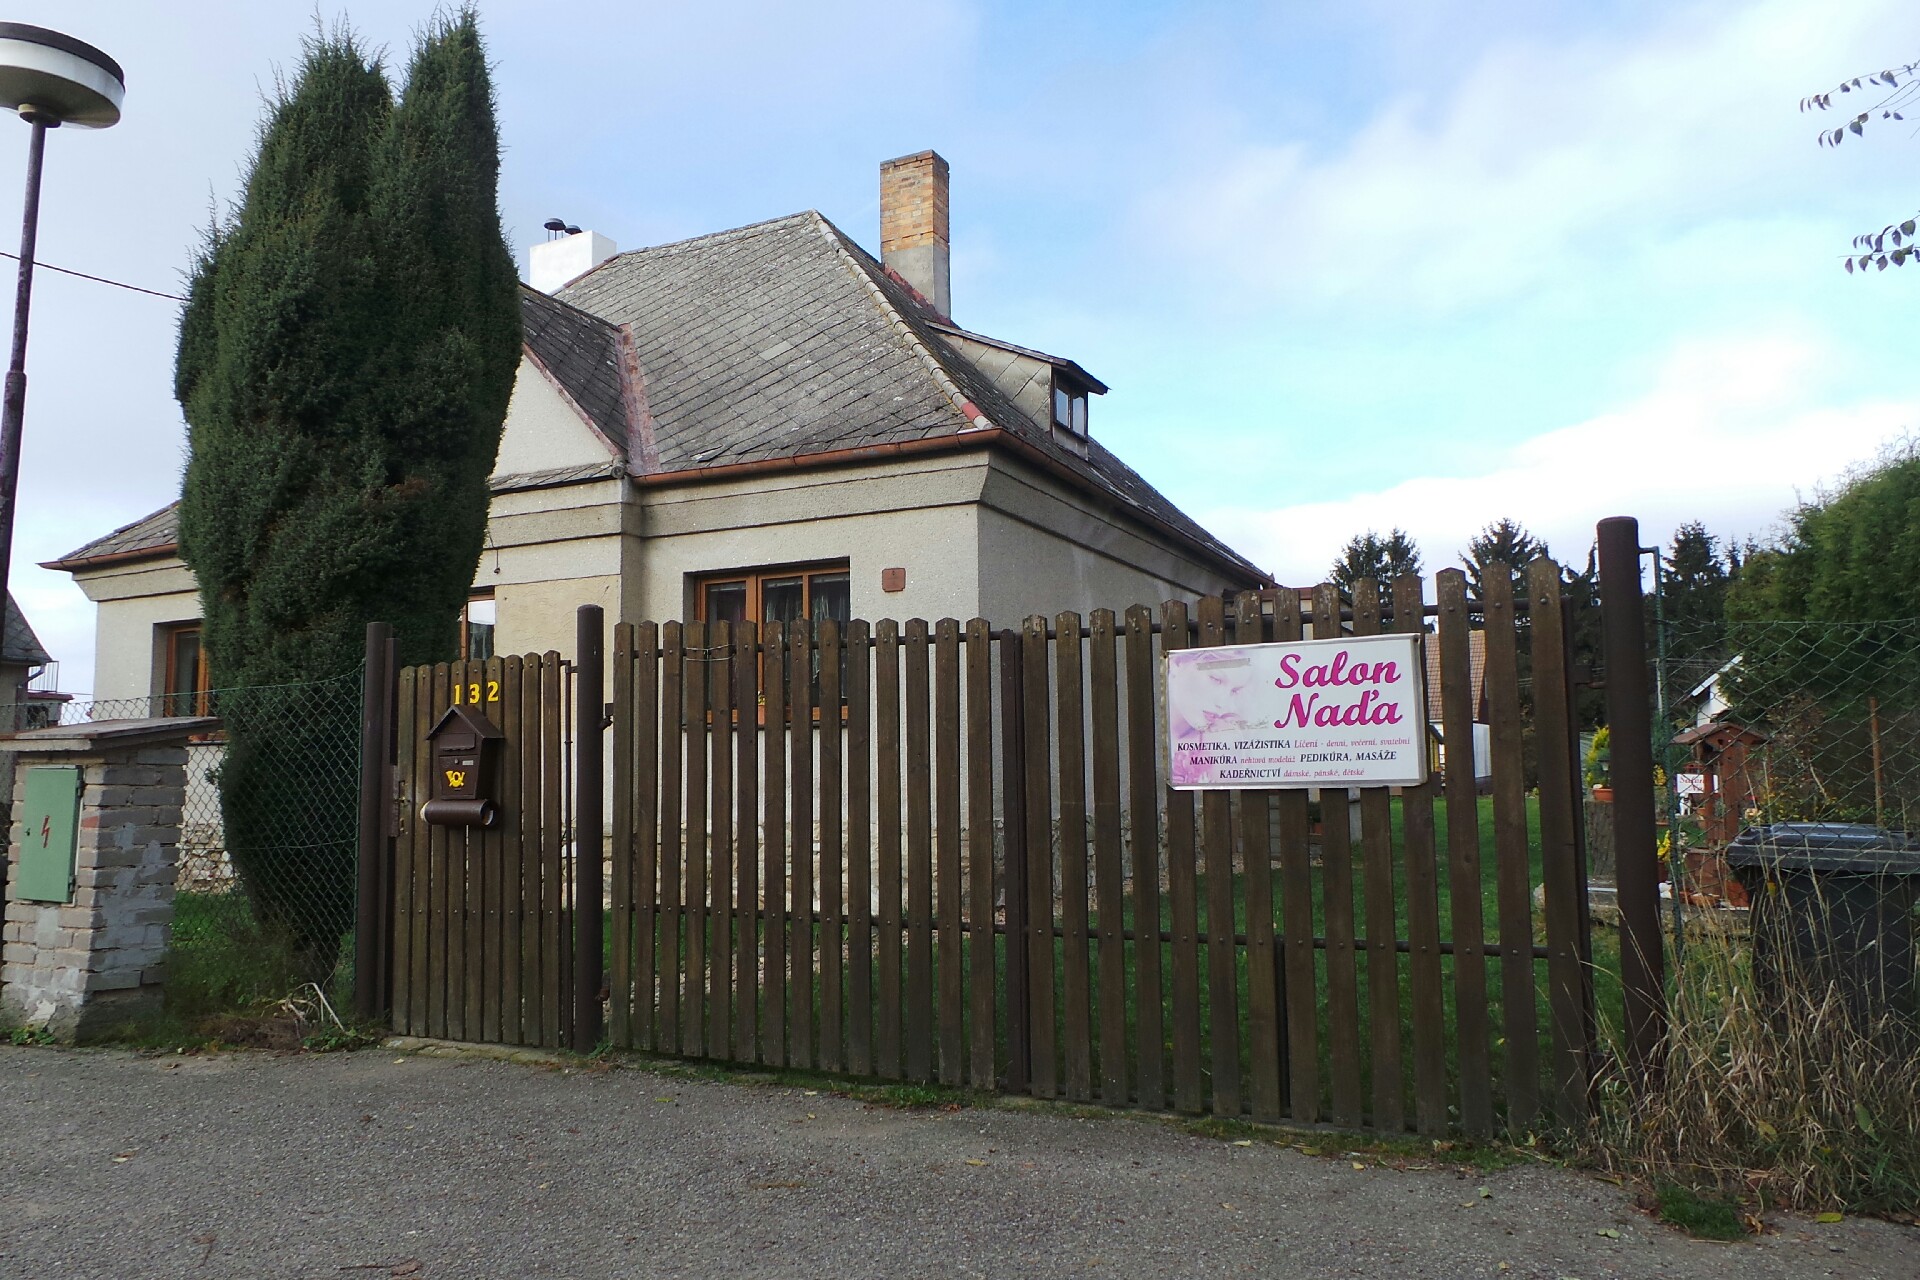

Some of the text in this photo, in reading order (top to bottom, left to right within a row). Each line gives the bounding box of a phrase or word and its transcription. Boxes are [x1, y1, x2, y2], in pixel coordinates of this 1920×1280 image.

[1275, 651, 1401, 689] Salon
[454, 681, 499, 704] 132
[1274, 689, 1403, 729] Naďa
[1234, 739, 1291, 750] VIZÁŽISTIKA
[1294, 739, 1318, 748] Líčení
[1380, 737, 1410, 746] svatební
[1189, 754, 1237, 765] MANIKÚRA
[1300, 751, 1352, 762] PEDIKÚRA,
[1355, 750, 1397, 760] MASÁŽE
[1220, 767, 1281, 778] KADEŘNICTVÍ
[1342, 768, 1364, 776] dětské
